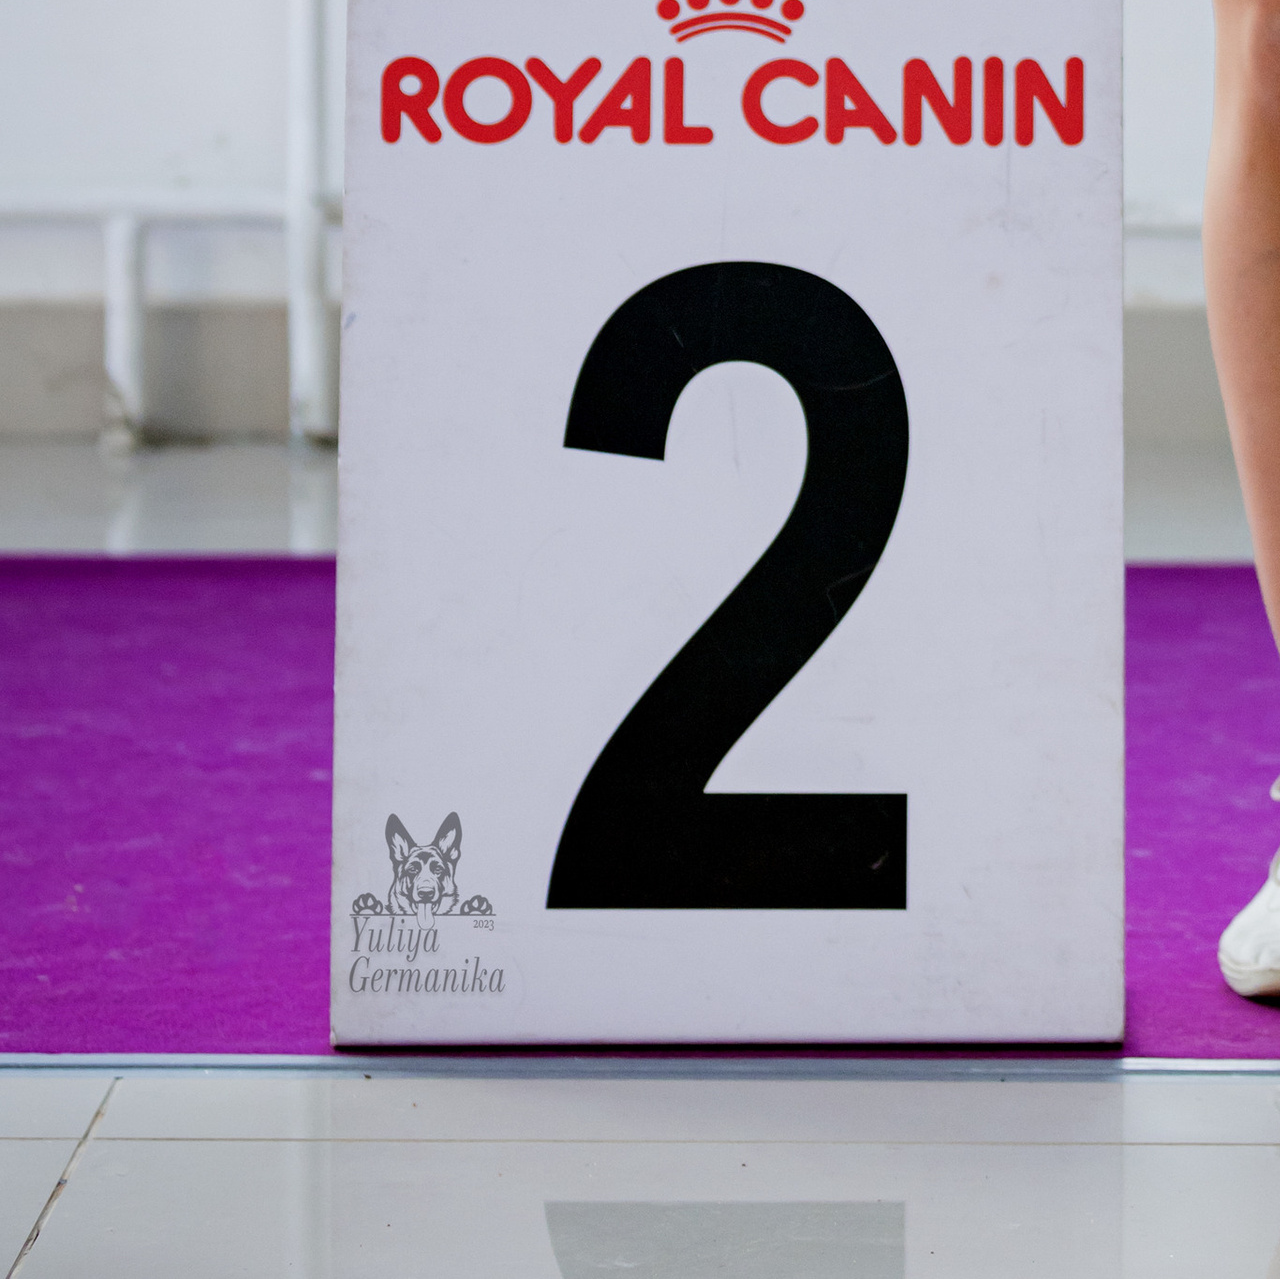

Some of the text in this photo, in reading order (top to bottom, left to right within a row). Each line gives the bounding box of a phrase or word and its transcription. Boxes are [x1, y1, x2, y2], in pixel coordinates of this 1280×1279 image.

[380, 55, 1085, 147] ROYAL CANIN
[546, 261, 910, 910] 2
